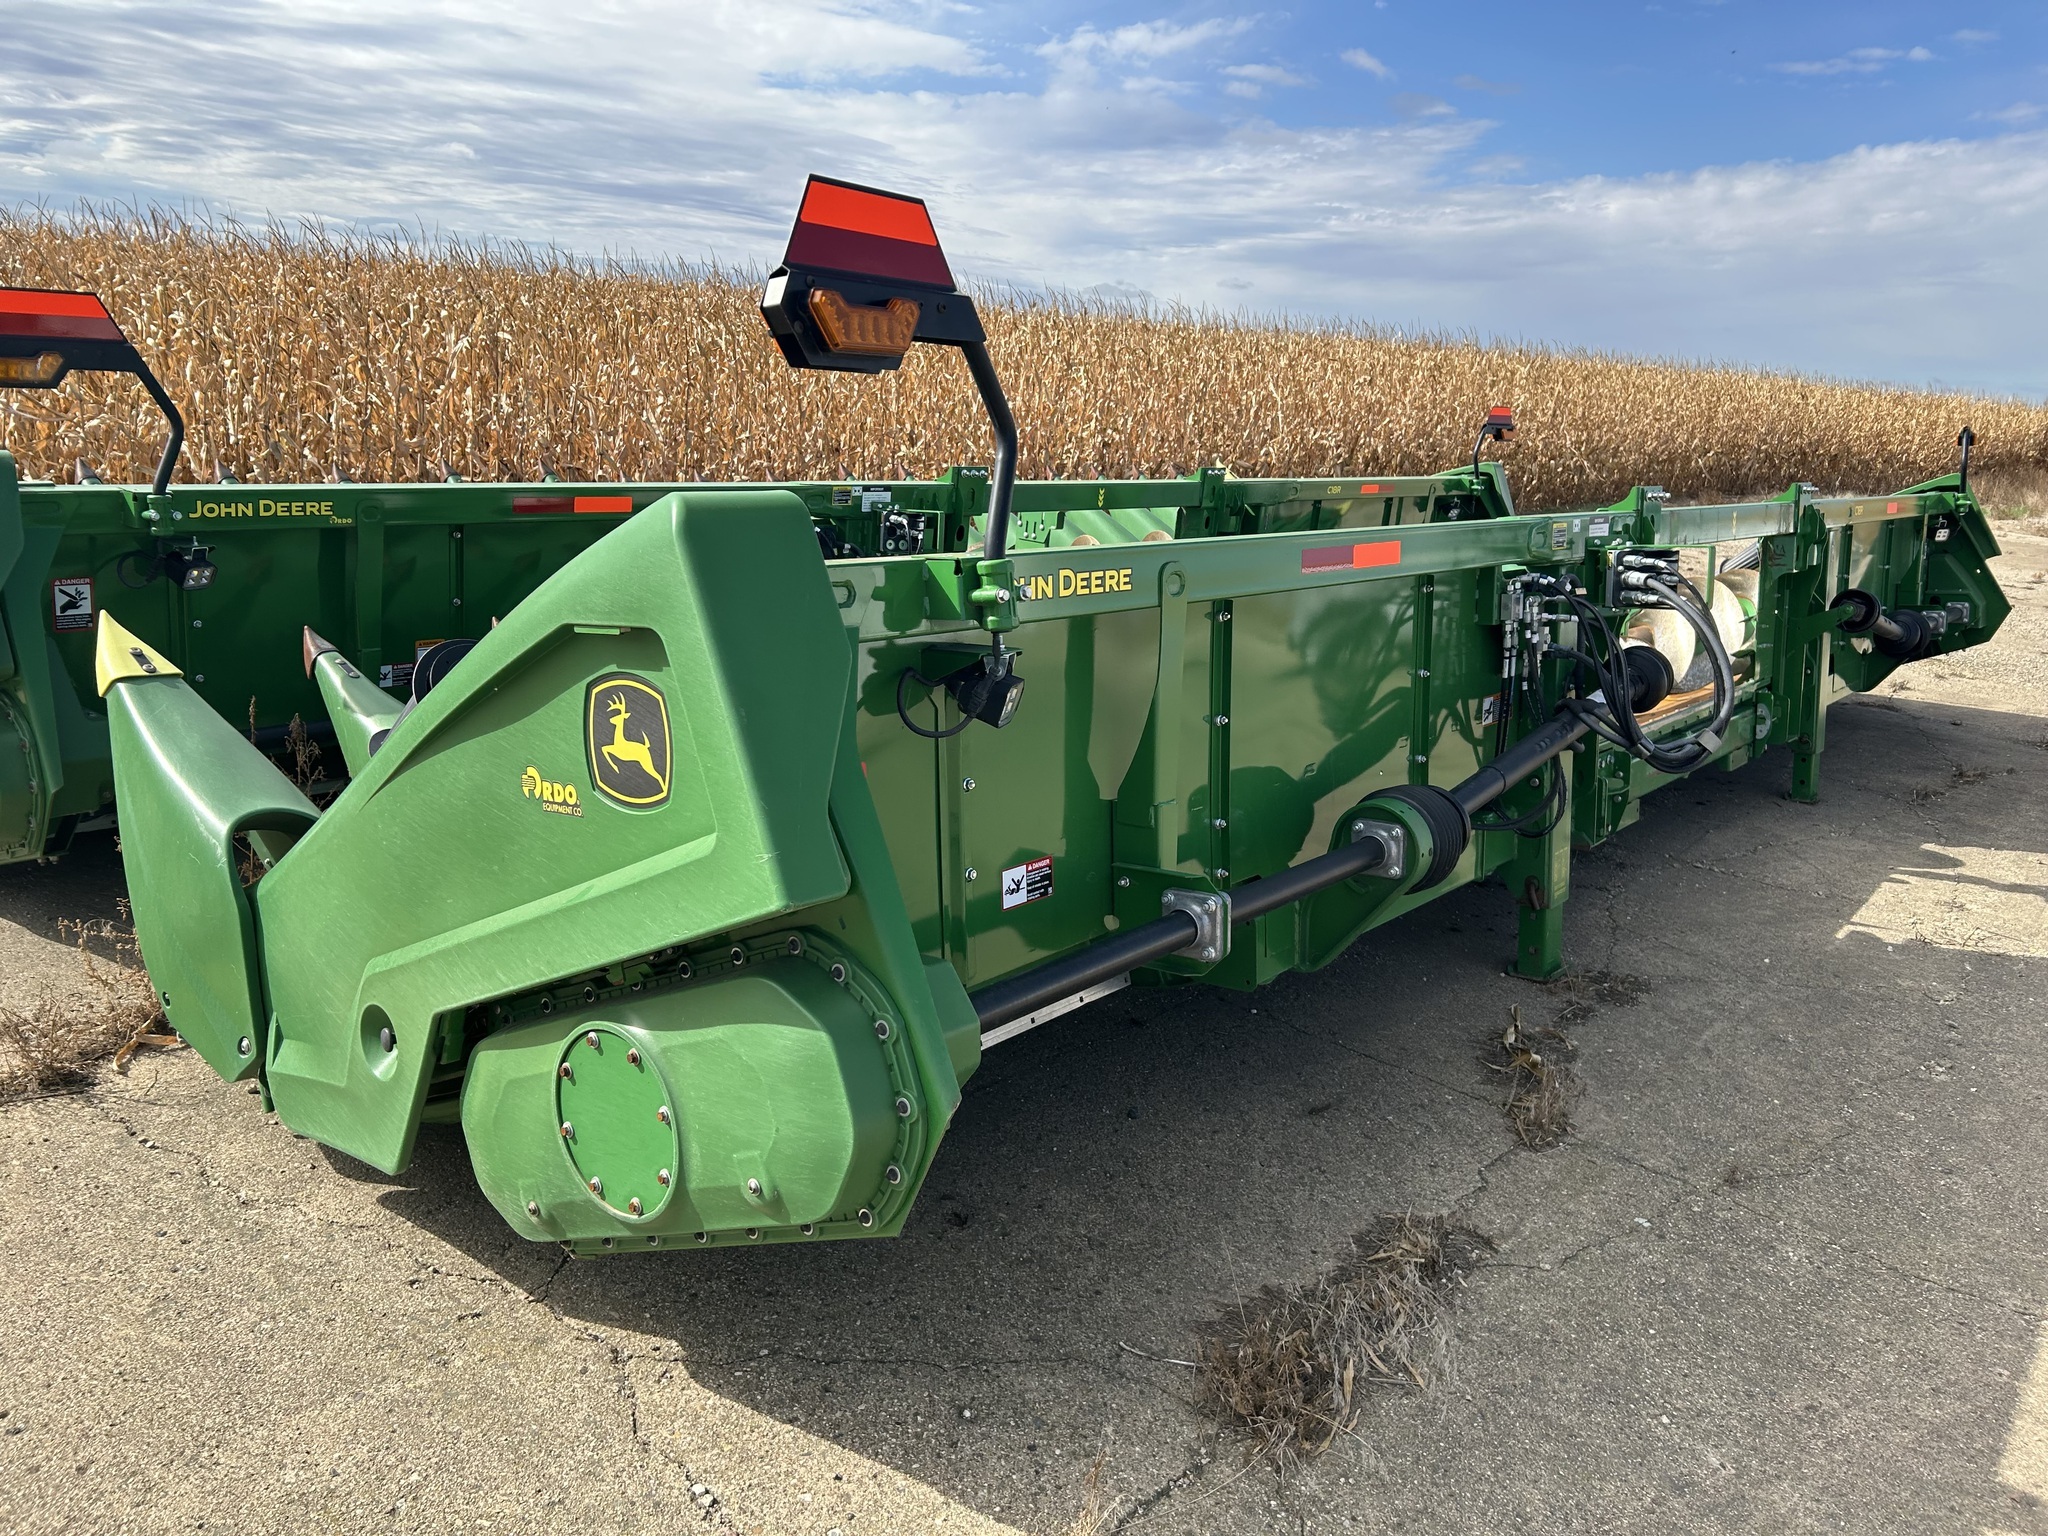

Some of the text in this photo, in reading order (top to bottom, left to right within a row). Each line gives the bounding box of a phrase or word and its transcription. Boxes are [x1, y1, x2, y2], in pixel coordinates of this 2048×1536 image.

[188, 499, 333, 518] JOHN DEERE
[1058, 568, 1132, 598] DEERE
[542, 802, 573, 815] EQUIPMENT
[1032, 858, 1050, 870] DANGER
